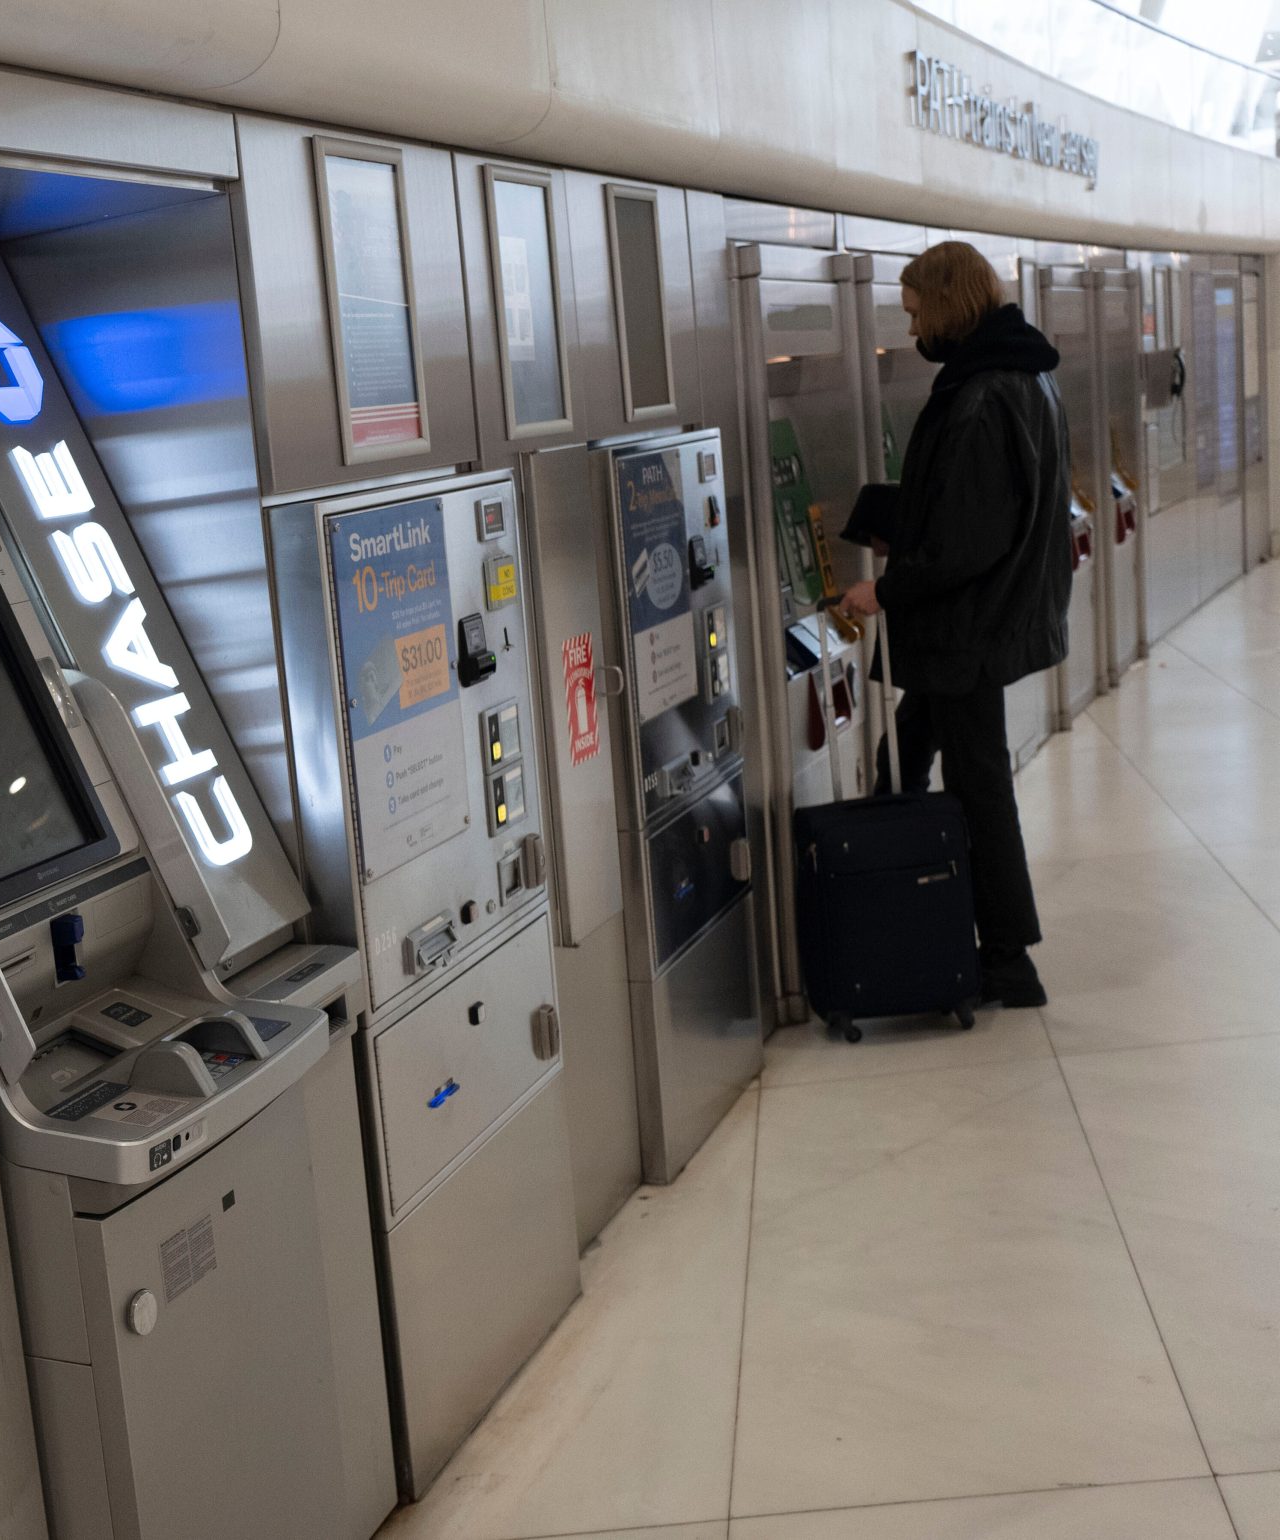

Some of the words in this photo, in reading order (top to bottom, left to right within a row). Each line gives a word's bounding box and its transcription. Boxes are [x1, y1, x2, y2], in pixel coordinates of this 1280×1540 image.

[906, 50, 963, 140] PATH
[641, 465, 663, 485] PATH
[349, 518, 431, 562] SmartLink
[352, 563, 406, 614] 10-Trip
[407, 558, 436, 593] Card
[8, 439, 253, 867] CHASE
[401, 635, 443, 674] $31.00
[568, 643, 588, 668] FIRE
[574, 732, 595, 752] INSIDE
